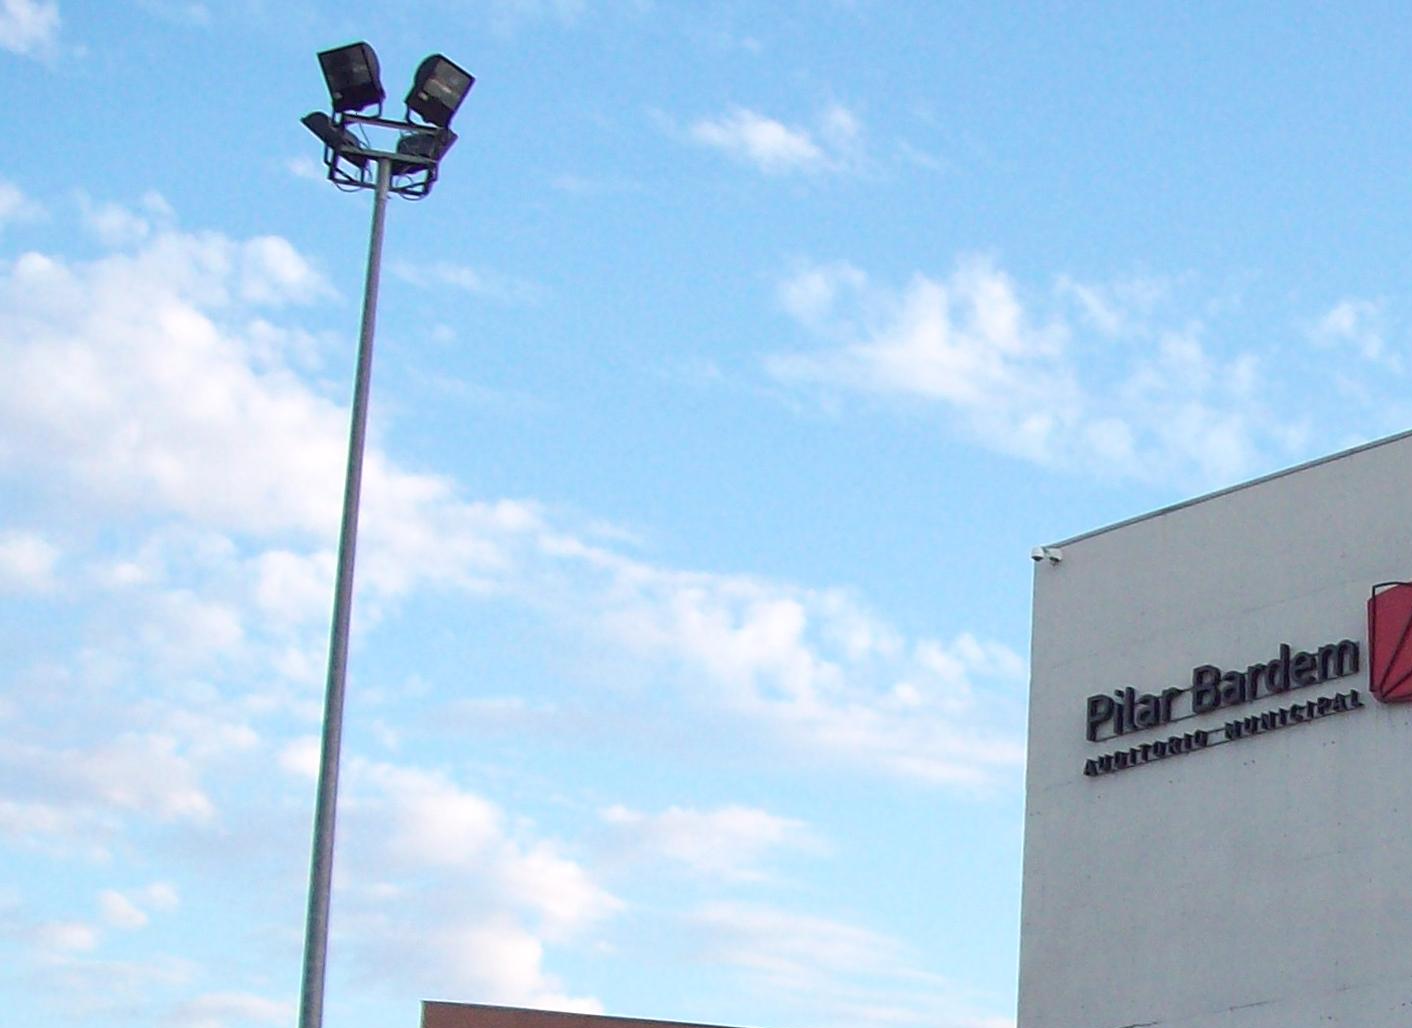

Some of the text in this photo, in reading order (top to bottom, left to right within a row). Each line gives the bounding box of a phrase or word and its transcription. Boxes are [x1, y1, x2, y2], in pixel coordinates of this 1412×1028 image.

[1084, 689, 1365, 776] AUDITORIO MUNICIPAL
[1086, 639, 1359, 741] Pilar Bardem
